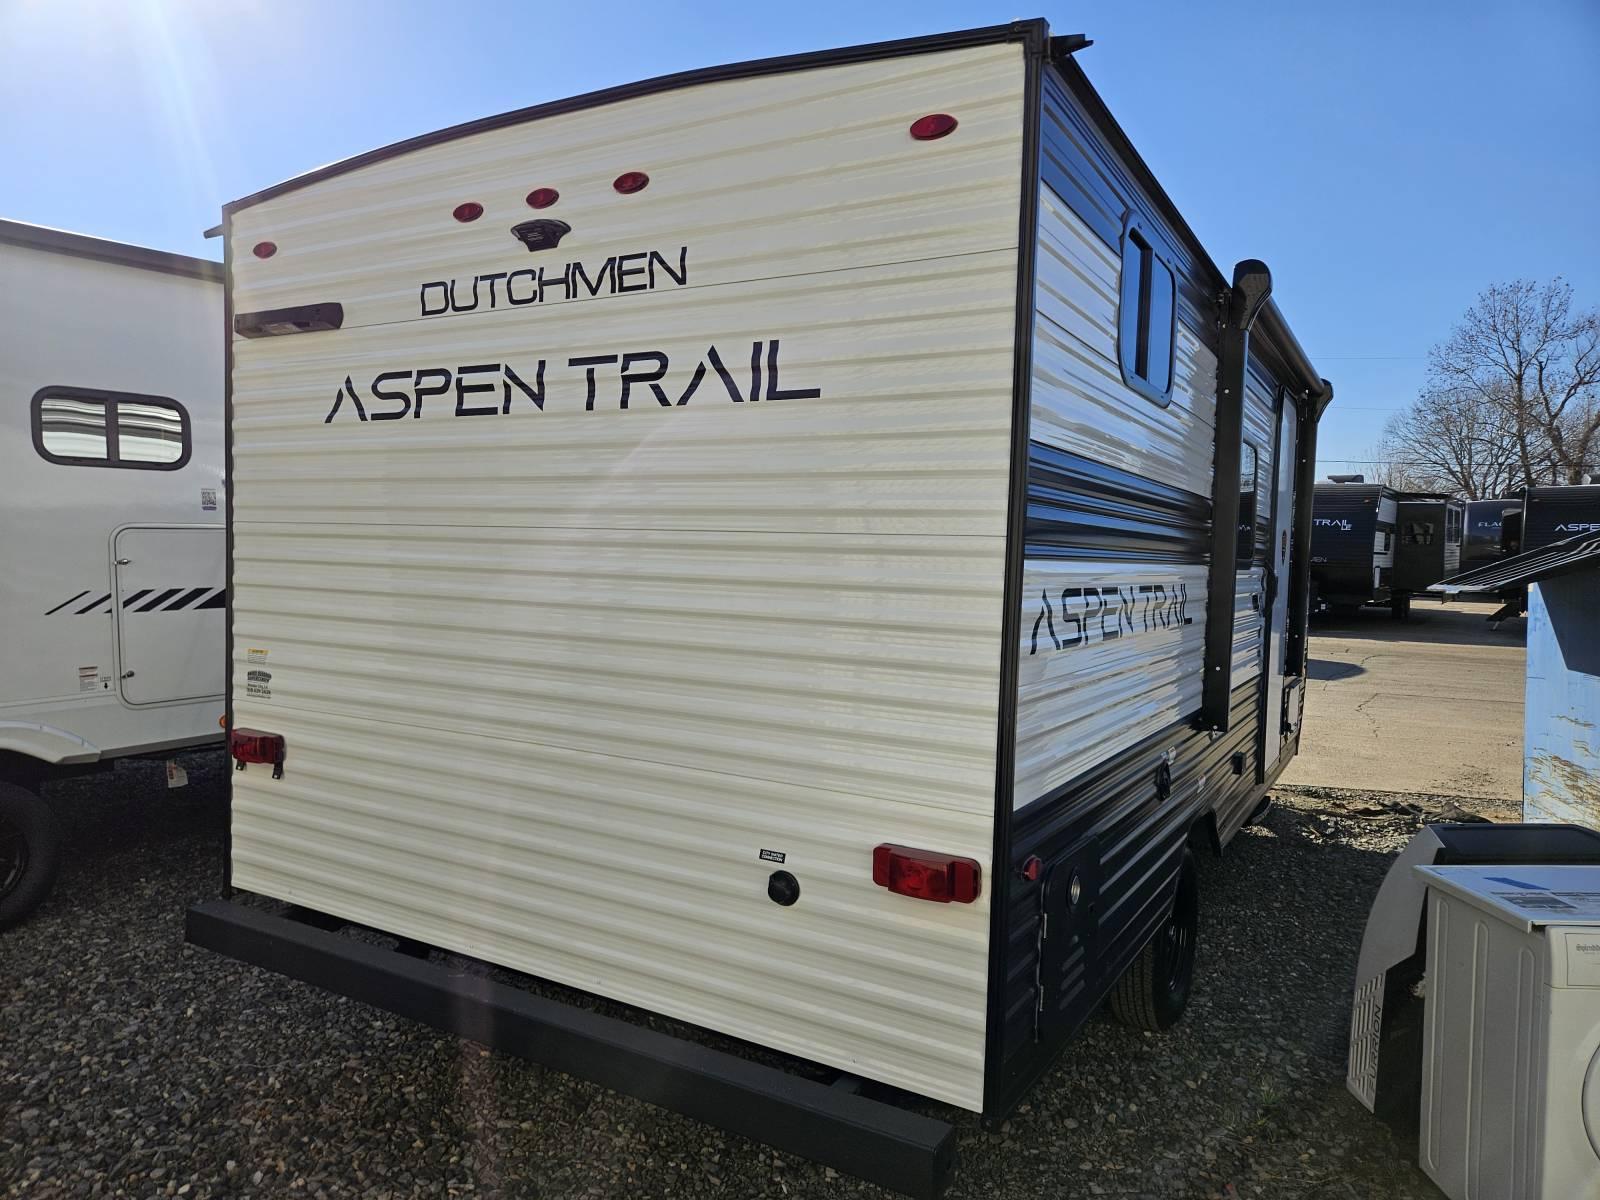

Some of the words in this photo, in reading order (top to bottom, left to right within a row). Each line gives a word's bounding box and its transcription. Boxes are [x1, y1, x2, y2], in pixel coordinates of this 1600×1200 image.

[421, 246, 688, 316] DUTCHMEN
[324, 359, 547, 424] ASPEN
[567, 339, 821, 411] TRAIL
[1029, 584, 1135, 655] ASPEN
[1138, 583, 1192, 633] TRAIL
[1368, 1005, 1381, 1092] FURRION
